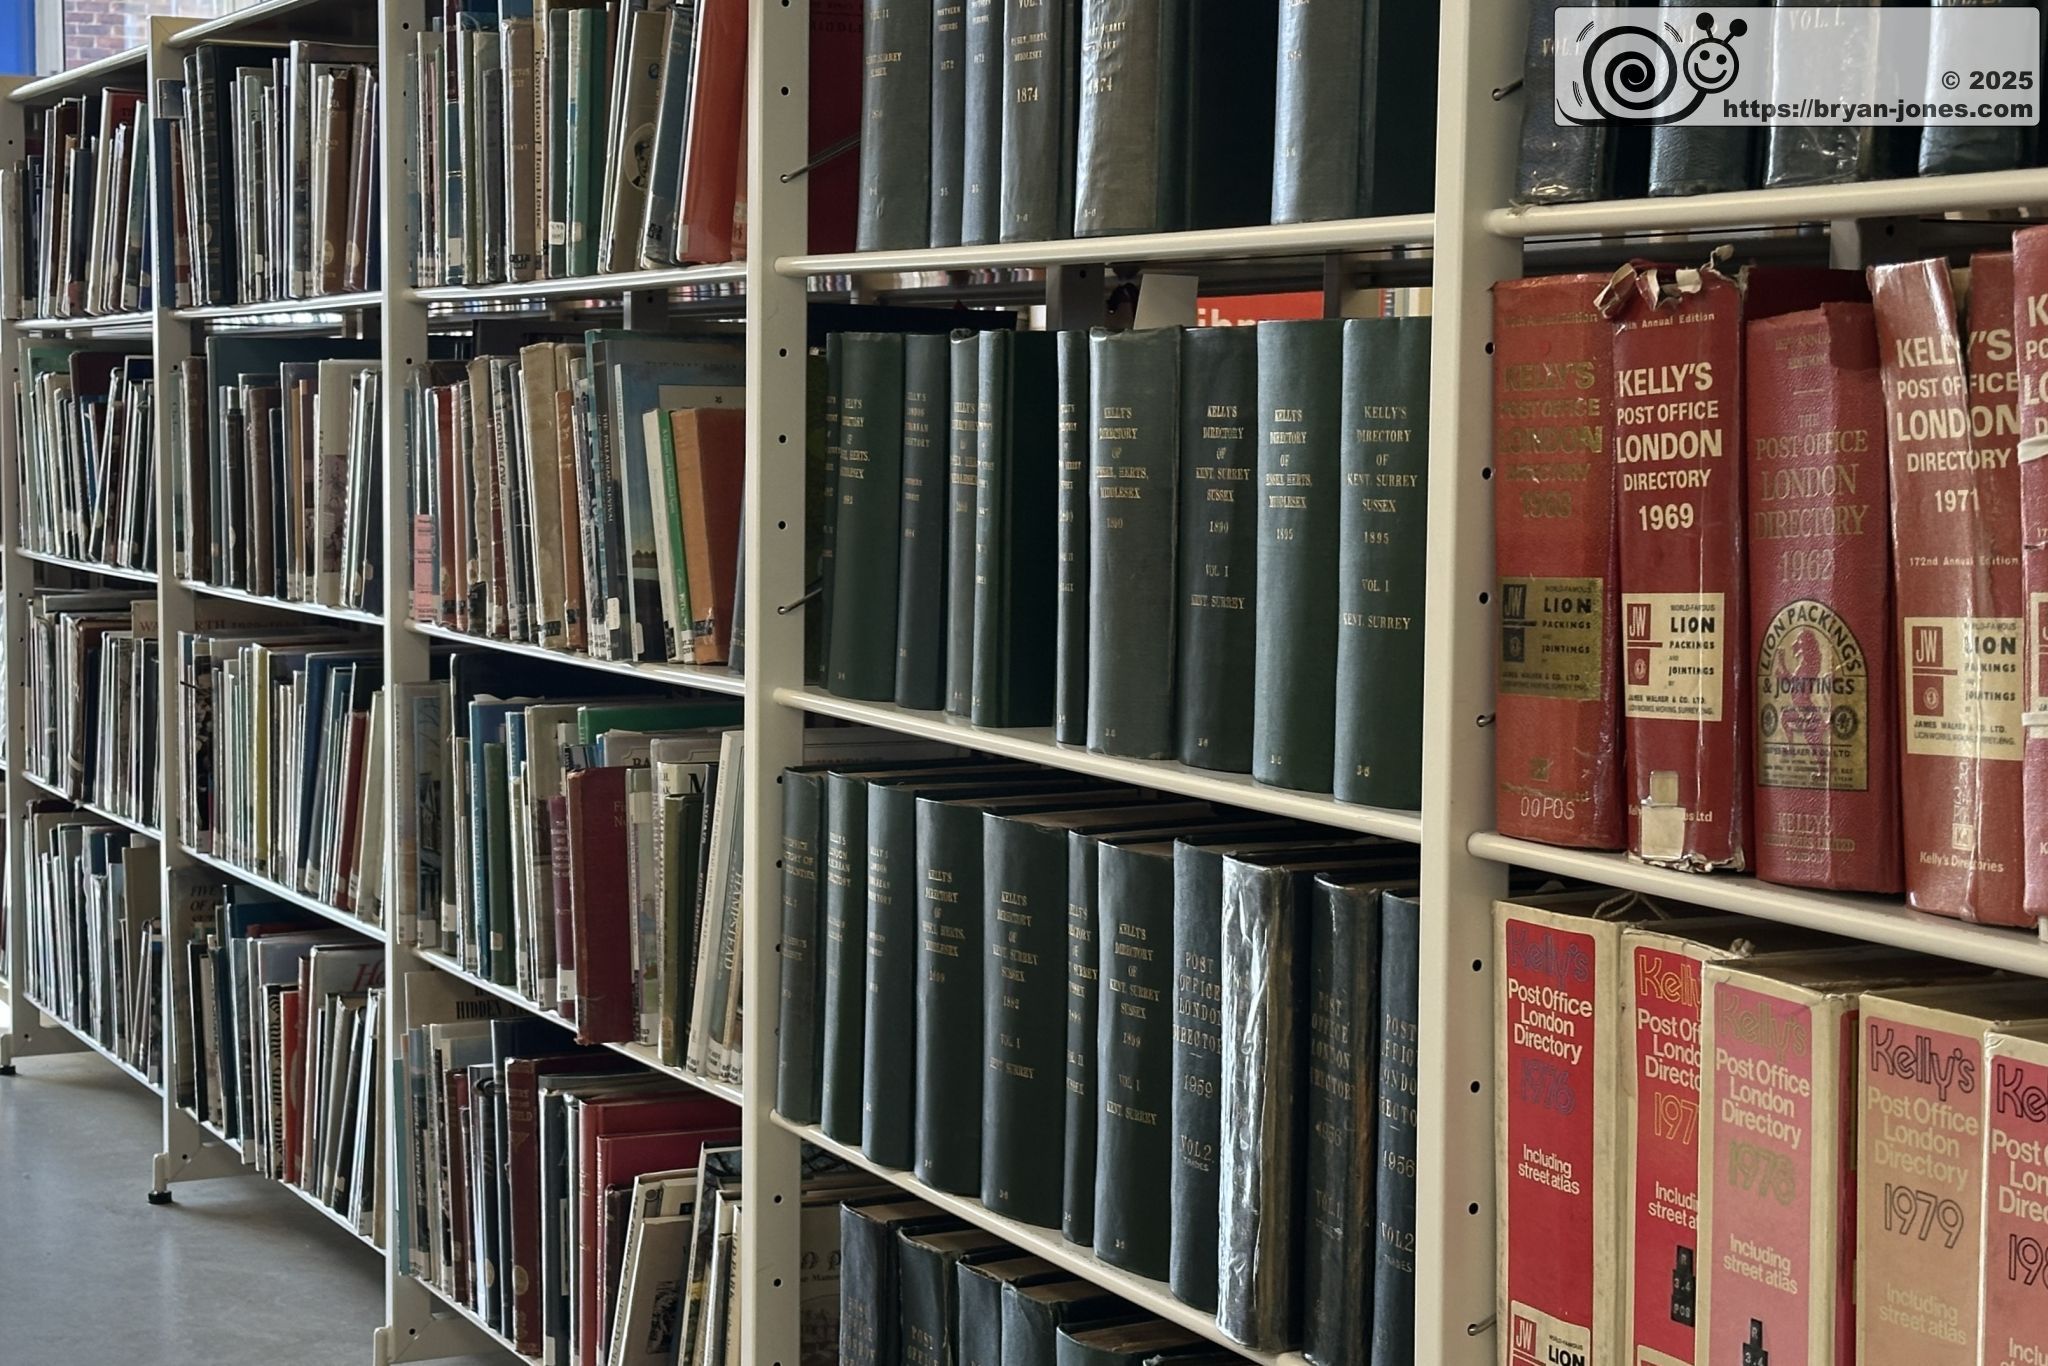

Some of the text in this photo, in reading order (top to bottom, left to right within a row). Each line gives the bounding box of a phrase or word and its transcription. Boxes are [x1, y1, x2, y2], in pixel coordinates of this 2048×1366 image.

[534, 50, 543, 129] Decoration
[1016, 86, 1039, 103] 1874
[1641, 317, 1674, 329] Annual
[1679, 312, 1715, 325] Edition
[1618, 361, 1713, 398] KELLY'S
[1897, 377, 1937, 400] POST
[1206, 405, 1239, 418] KELLY'S
[1364, 406, 1408, 420] KELLY'S
[1617, 400, 1719, 426] POST OFFICE
[1896, 404, 2020, 442] LONDON
[1203, 426, 1245, 439] DIRECTORY
[1356, 429, 1413, 443] DIRECTORY
[1500, 425, 1603, 454] LONDON
[1616, 428, 1723, 463] LONDON
[1756, 430, 1868, 460] POST OFFICE
[1279, 454, 1291, 467] OF
[1376, 453, 1390, 466] OF
[1907, 448, 2011, 472] DIRECTORY
[1375, 474, 1419, 488] SURREY
[1623, 468, 1712, 492] DIRECTORY
[1761, 463, 1859, 501] LONDON
[1362, 499, 1397, 513] SUSSEX
[1934, 488, 1980, 514] 1971
[1638, 502, 1694, 532] 1969
[1754, 504, 1870, 540] DIRECTORY
[1276, 527, 1295, 541] 1895
[1363, 531, 1390, 544] 1895
[1909, 556, 2019, 567] 172nd Annual Edition
[1543, 598, 1592, 614] LION
[1368, 614, 1412, 631] SURREY
[1542, 620, 1591, 630] PACKINGS
[1629, 606, 1648, 638] JW
[1670, 617, 1716, 634] LION
[1541, 645, 1590, 655] JOINTINGS
[1669, 640, 1715, 650] PACKINGS
[1759, 604, 1863, 673] LION PACKINGS
[1915, 629, 1938, 663] JW
[1964, 636, 2017, 655] LION
[1668, 665, 1715, 676] JOINTINGS
[1762, 675, 1855, 699] & JOINTINGS
[1914, 720, 1938, 729] JAMES
[1696, 810, 1713, 823] Ltd
[1777, 811, 1832, 836] KELLY'S
[1920, 851, 2005, 874] Kelly's Directories
[1001, 890, 1028, 906] KELLY'S
[725, 870, 743, 971] HAMPSTEAD
[1119, 923, 1147, 941] KELLY'S
[1184, 951, 1214, 976] POST
[1507, 925, 1591, 991] Kelly's
[1179, 973, 1222, 1001] OFFICE
[1508, 977, 1593, 1018] Post Office
[1385, 1013, 1417, 1042] POST
[1520, 1003, 1575, 1038] London
[1637, 1007, 1678, 1038] Post
[1716, 989, 1807, 1067] Kelly's
[1513, 1023, 1583, 1066] Directory
[1715, 1047, 1811, 1098] Post Office
[1870, 1023, 1976, 1102] Kelly's
[1730, 1076, 1795, 1119] London
[1867, 1085, 1979, 1138] Post Office
[1721, 1100, 1802, 1151] Directory
[1882, 1115, 1961, 1160] London
[1992, 1128, 2041, 1166] Post
[1382, 1149, 1416, 1178] 1956
[1522, 1143, 1572, 1179] Including
[1873, 1144, 1969, 1194] Directory
[1518, 1161, 1581, 1196] street atlas
[1648, 1201, 1687, 1228] street
[1883, 1182, 1965, 1250] 1979
[1680, 1253, 1687, 1265] R
[1729, 1233, 1792, 1277] Including
[1673, 1277, 1692, 1292] 3.4
[1722, 1254, 1798, 1296] street atlas
[1673, 1304, 1691, 1318] POS
[1885, 1282, 1960, 1328] Including
[1516, 1318, 1533, 1350] JW
[1751, 1326, 1759, 1340] R
[1879, 1303, 1968, 1347] street atlas
[1548, 1344, 1586, 1366] LION
